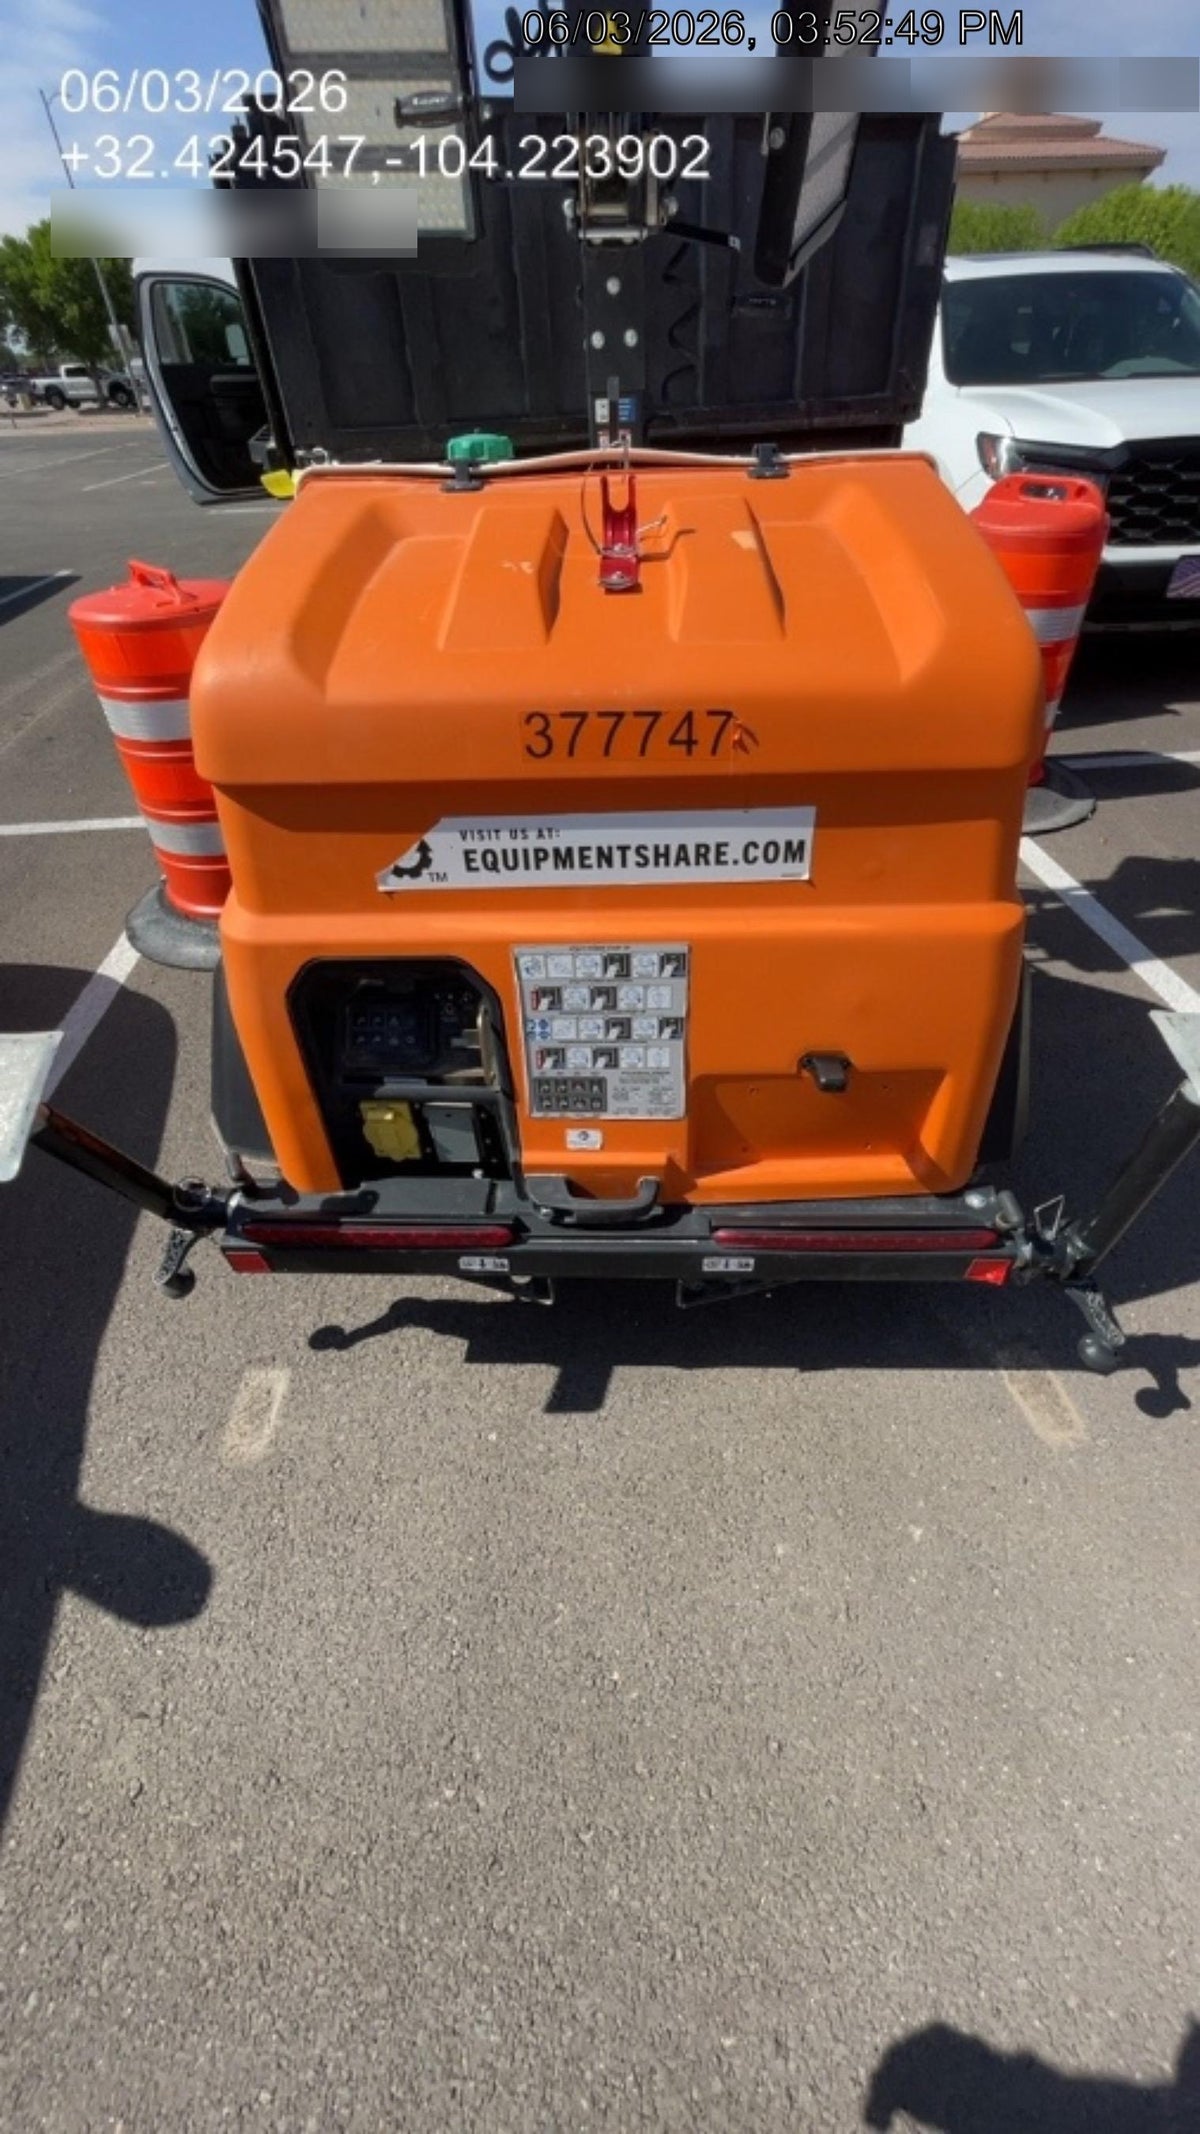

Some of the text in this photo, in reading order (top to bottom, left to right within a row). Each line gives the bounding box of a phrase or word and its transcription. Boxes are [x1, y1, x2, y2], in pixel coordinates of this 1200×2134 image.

[524, 710, 734, 758] 377747
[460, 827, 561, 841] VISIT US AT:
[463, 839, 806, 873] EQUIPMENTSHARE.COM
[427, 872, 449, 883] TM
